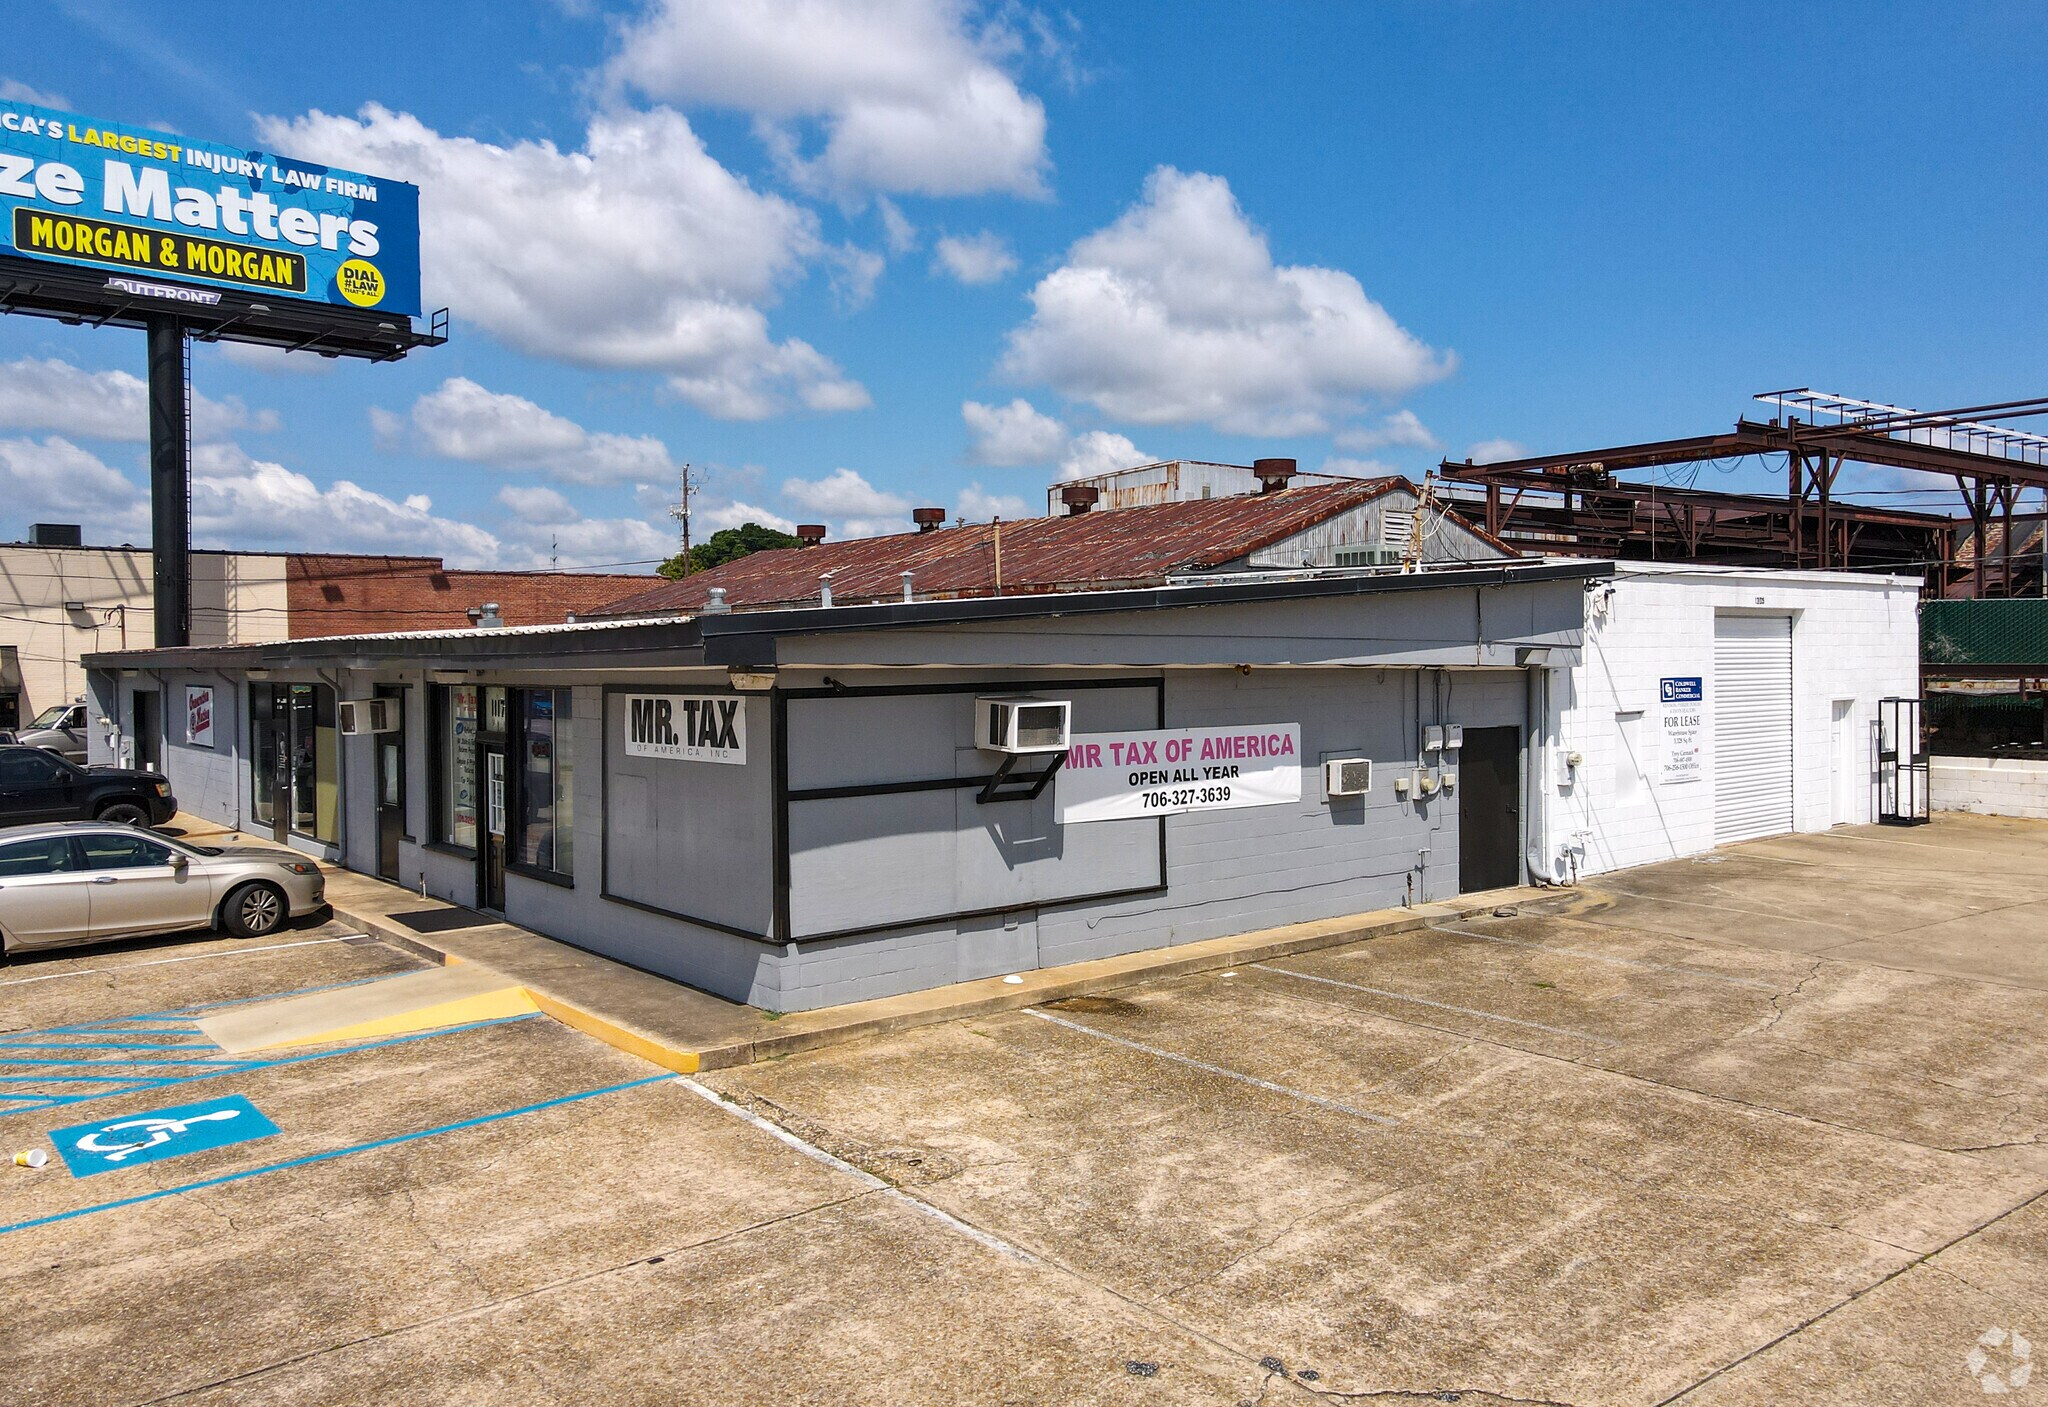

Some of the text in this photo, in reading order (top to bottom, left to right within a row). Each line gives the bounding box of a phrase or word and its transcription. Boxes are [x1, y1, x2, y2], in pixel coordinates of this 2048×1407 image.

[0, 112, 378, 202] CA'S LARGEST INJURY LAW FIRM
[104, 160, 380, 257] Matters
[31, 216, 150, 263] MORGAN
[159, 238, 179, 267] &
[343, 266, 379, 283] DIAL
[344, 278, 379, 292] #LAW
[113, 281, 217, 305] OUTFRONT
[491, 699, 505, 718] 1117
[631, 698, 740, 749] MR. TAX
[1664, 715, 1700, 728] FOR LEASE
[636, 744, 648, 752] OF
[710, 750, 728, 759] INC
[1065, 733, 1294, 769] MR TAX OF AMERICA
[1128, 765, 1240, 786] OPEN ALL YEAR
[1142, 786, 1231, 808] 706-327-3639
